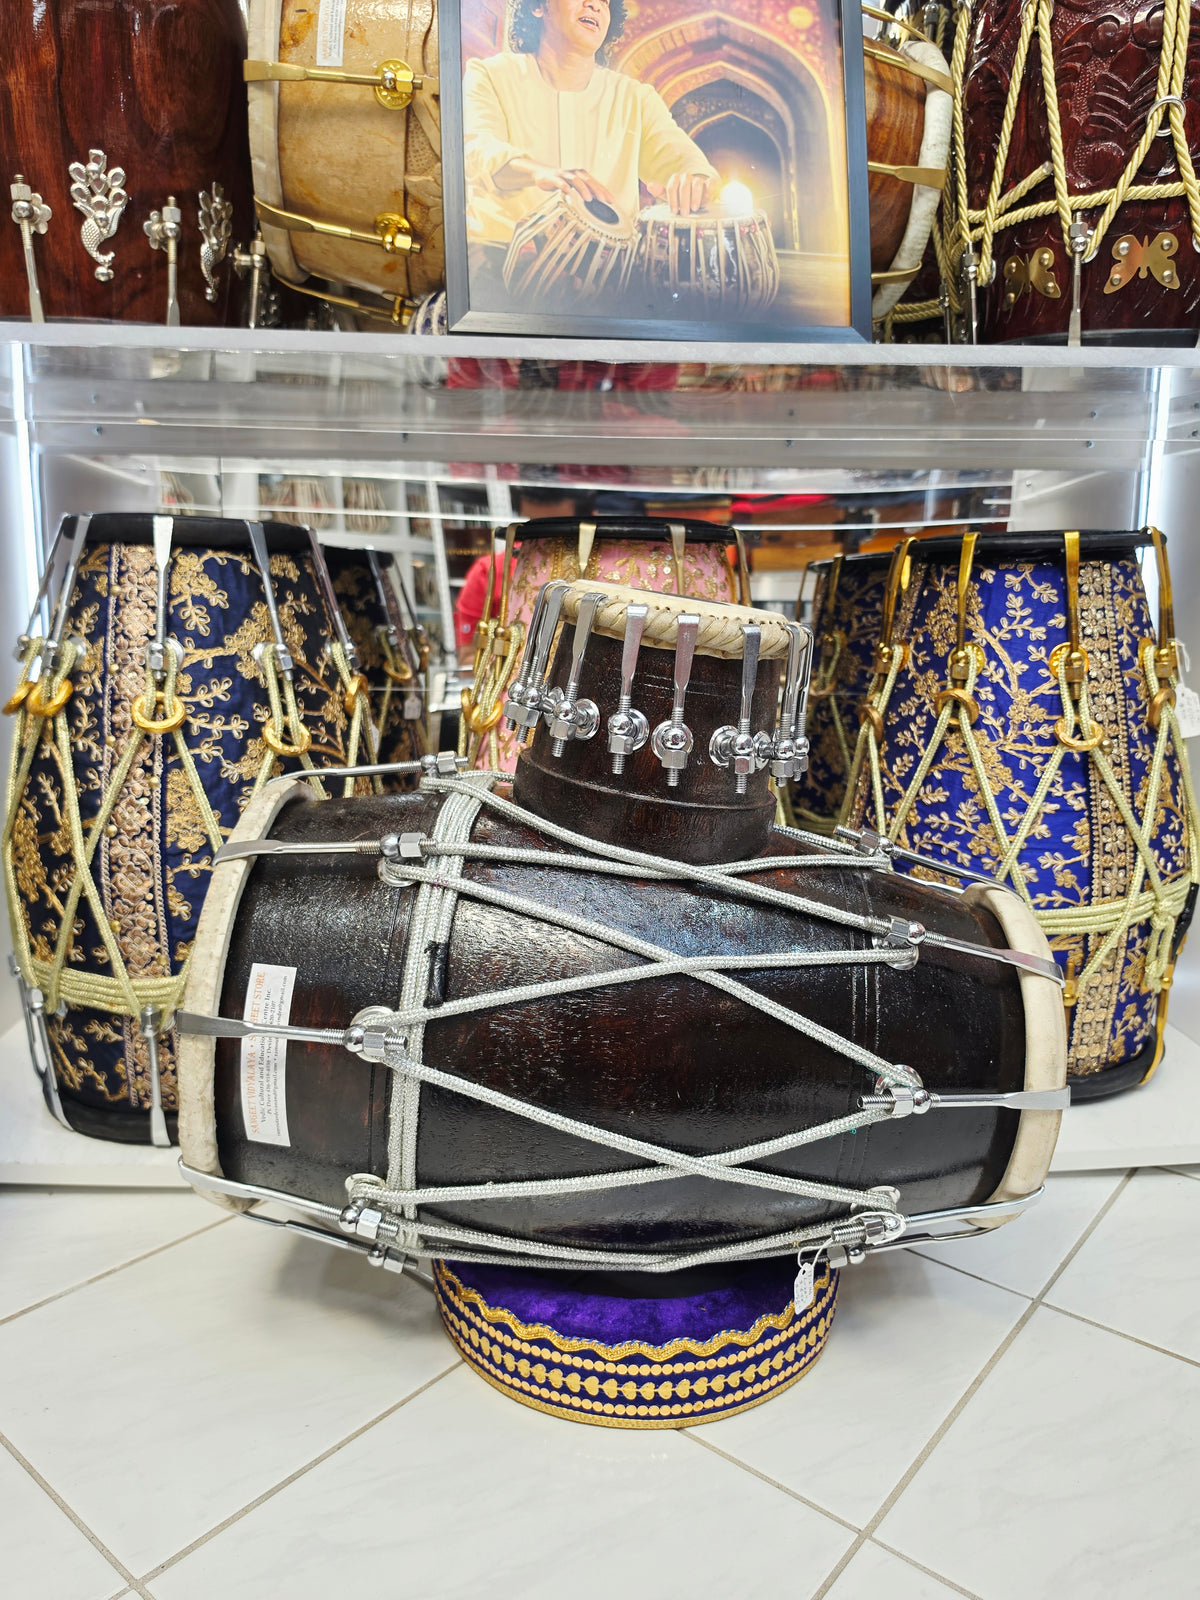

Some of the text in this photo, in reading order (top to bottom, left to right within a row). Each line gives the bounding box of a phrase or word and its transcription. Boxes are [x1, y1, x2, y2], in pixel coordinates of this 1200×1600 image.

[264, 987, 272, 1001] Inc.
[246, 1052, 256, 1098] VIDYALAYA
[253, 971, 266, 999] STORE
